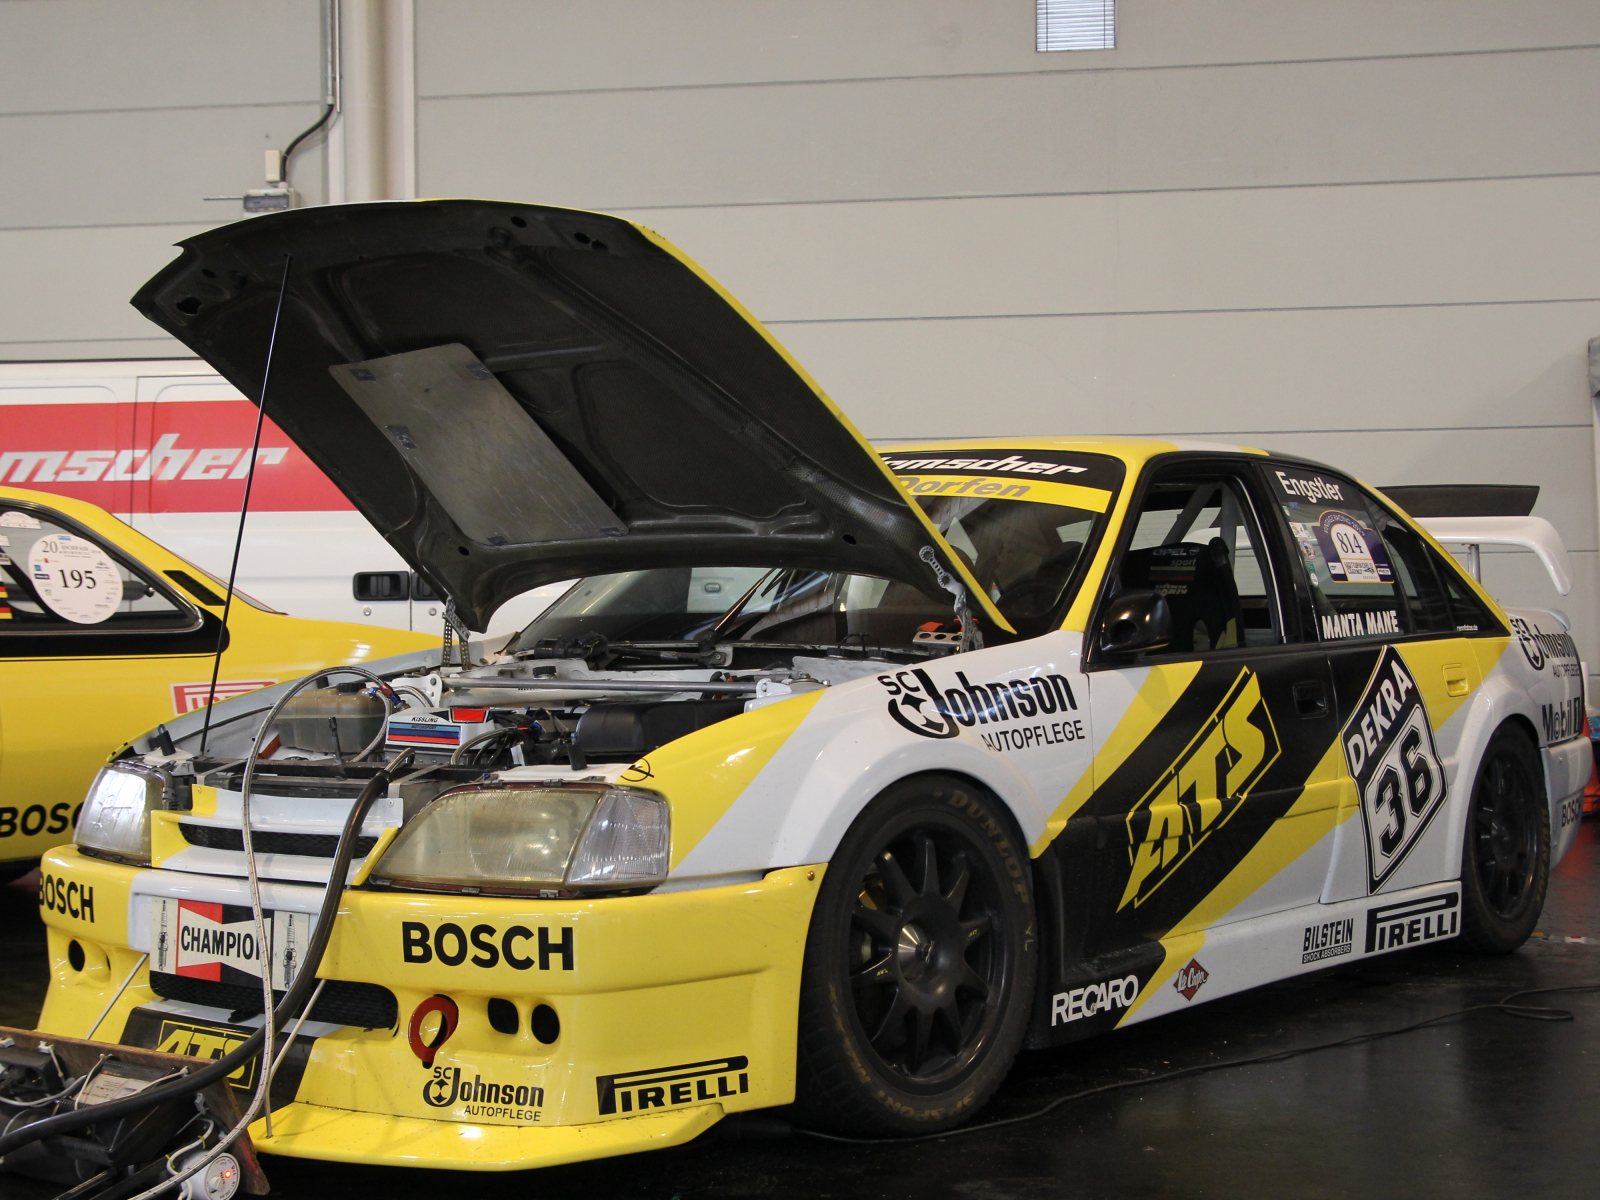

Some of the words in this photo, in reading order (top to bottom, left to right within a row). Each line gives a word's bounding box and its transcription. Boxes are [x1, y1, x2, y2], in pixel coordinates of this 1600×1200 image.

[1275, 471, 1344, 503] Engstler
[1152, 548, 1187, 556] OPEL
[1336, 532, 1365, 554] 814
[58, 569, 97, 589] 195
[1170, 558, 1196, 567] sport
[1322, 612, 1365, 639] MANTA
[1365, 610, 1399, 635] MANE
[877, 671, 921, 696] SC
[888, 668, 1078, 739] Johnson
[1347, 660, 1413, 777] DEKRA
[1541, 699, 1572, 742] Mobil
[981, 720, 1086, 753] AUTOPFLEGE
[1116, 671, 1266, 913] ATS
[1374, 724, 1435, 858] 36
[0, 801, 84, 838] BOS
[1303, 918, 1354, 952] BILSTEIN
[1365, 891, 1459, 954] PIRELLI
[180, 925, 261, 961] CHAMPIO
[402, 921, 575, 971] BOSCH
[1303, 950, 1321, 964] SHOCK
[1321, 943, 1352, 960] ABSORBERS
[1051, 974, 1139, 1027] RECARO
[423, 1067, 544, 1108] Johnson
[433, 1066, 452, 1080] SC
[595, 1055, 749, 1115] PIRELLI
[464, 1105, 541, 1122] AUTOPFLEGE
